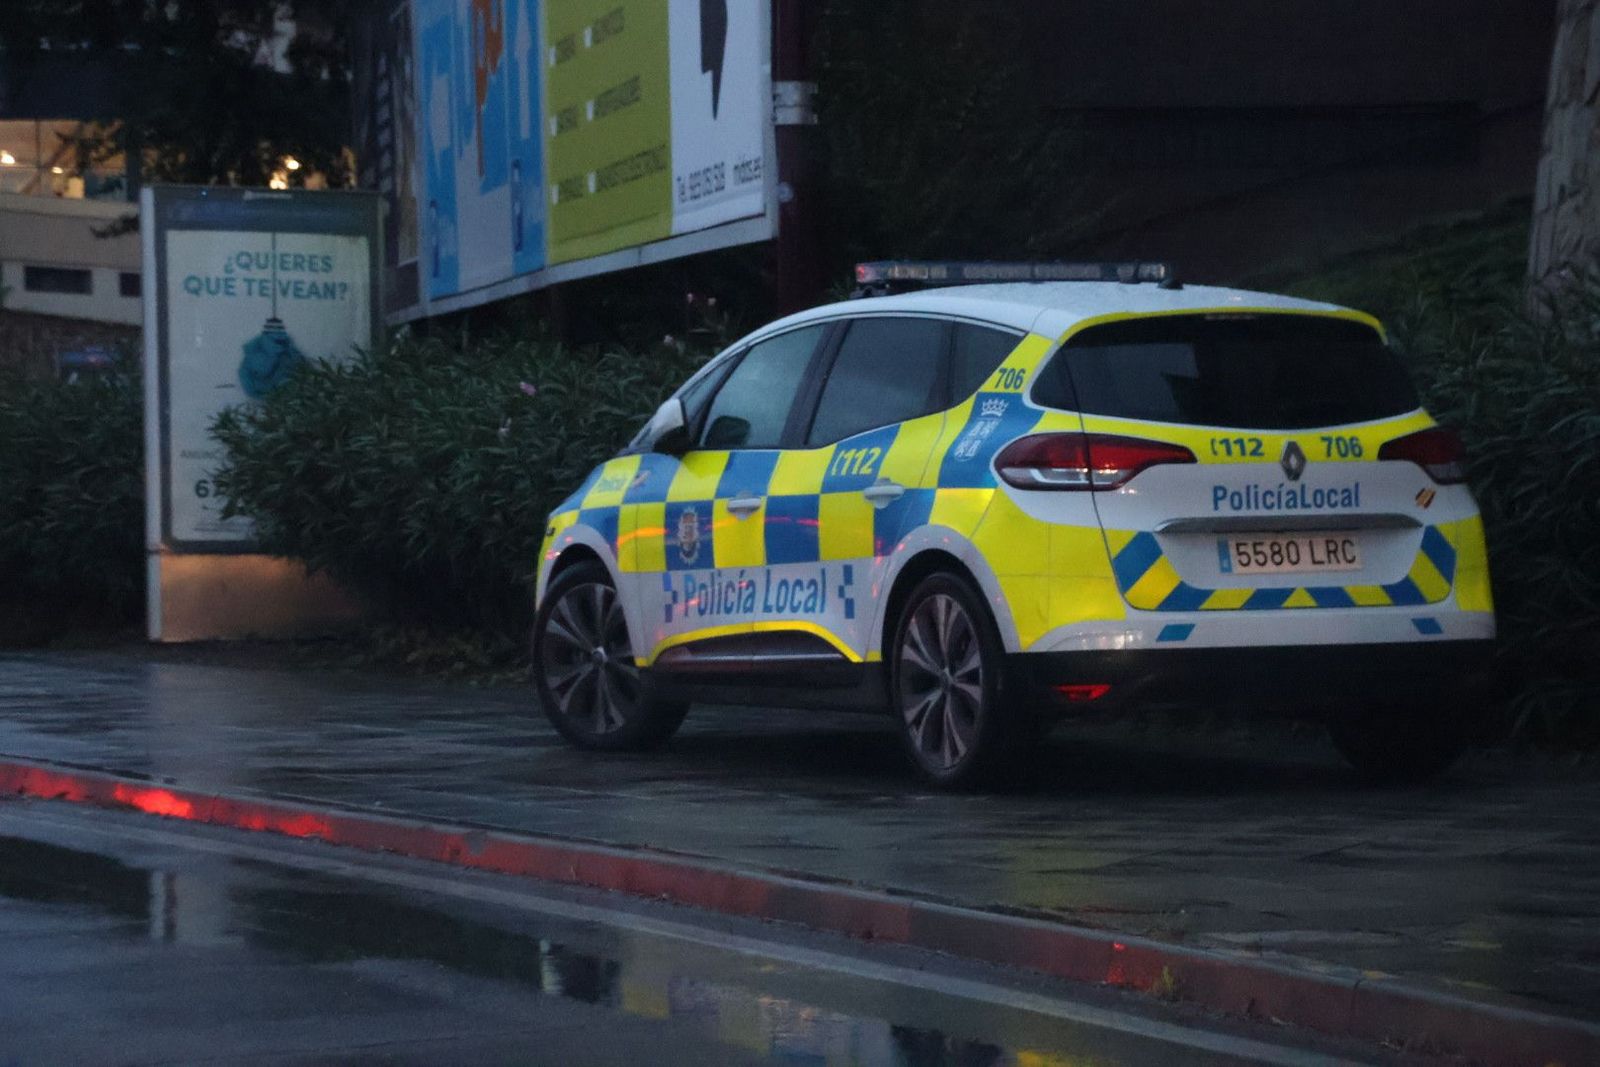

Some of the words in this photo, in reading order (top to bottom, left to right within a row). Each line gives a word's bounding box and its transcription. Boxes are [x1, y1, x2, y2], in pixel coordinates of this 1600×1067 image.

[243, 277, 273, 298] TE
[278, 281, 348, 300] VEAN?
[994, 368, 1026, 390] 706
[1320, 436, 1364, 458] 706
[1234, 540, 1300, 568] 5580
[1308, 539, 1357, 566] LRC
[684, 569, 756, 618] Policía
[762, 568, 827, 614] Local
